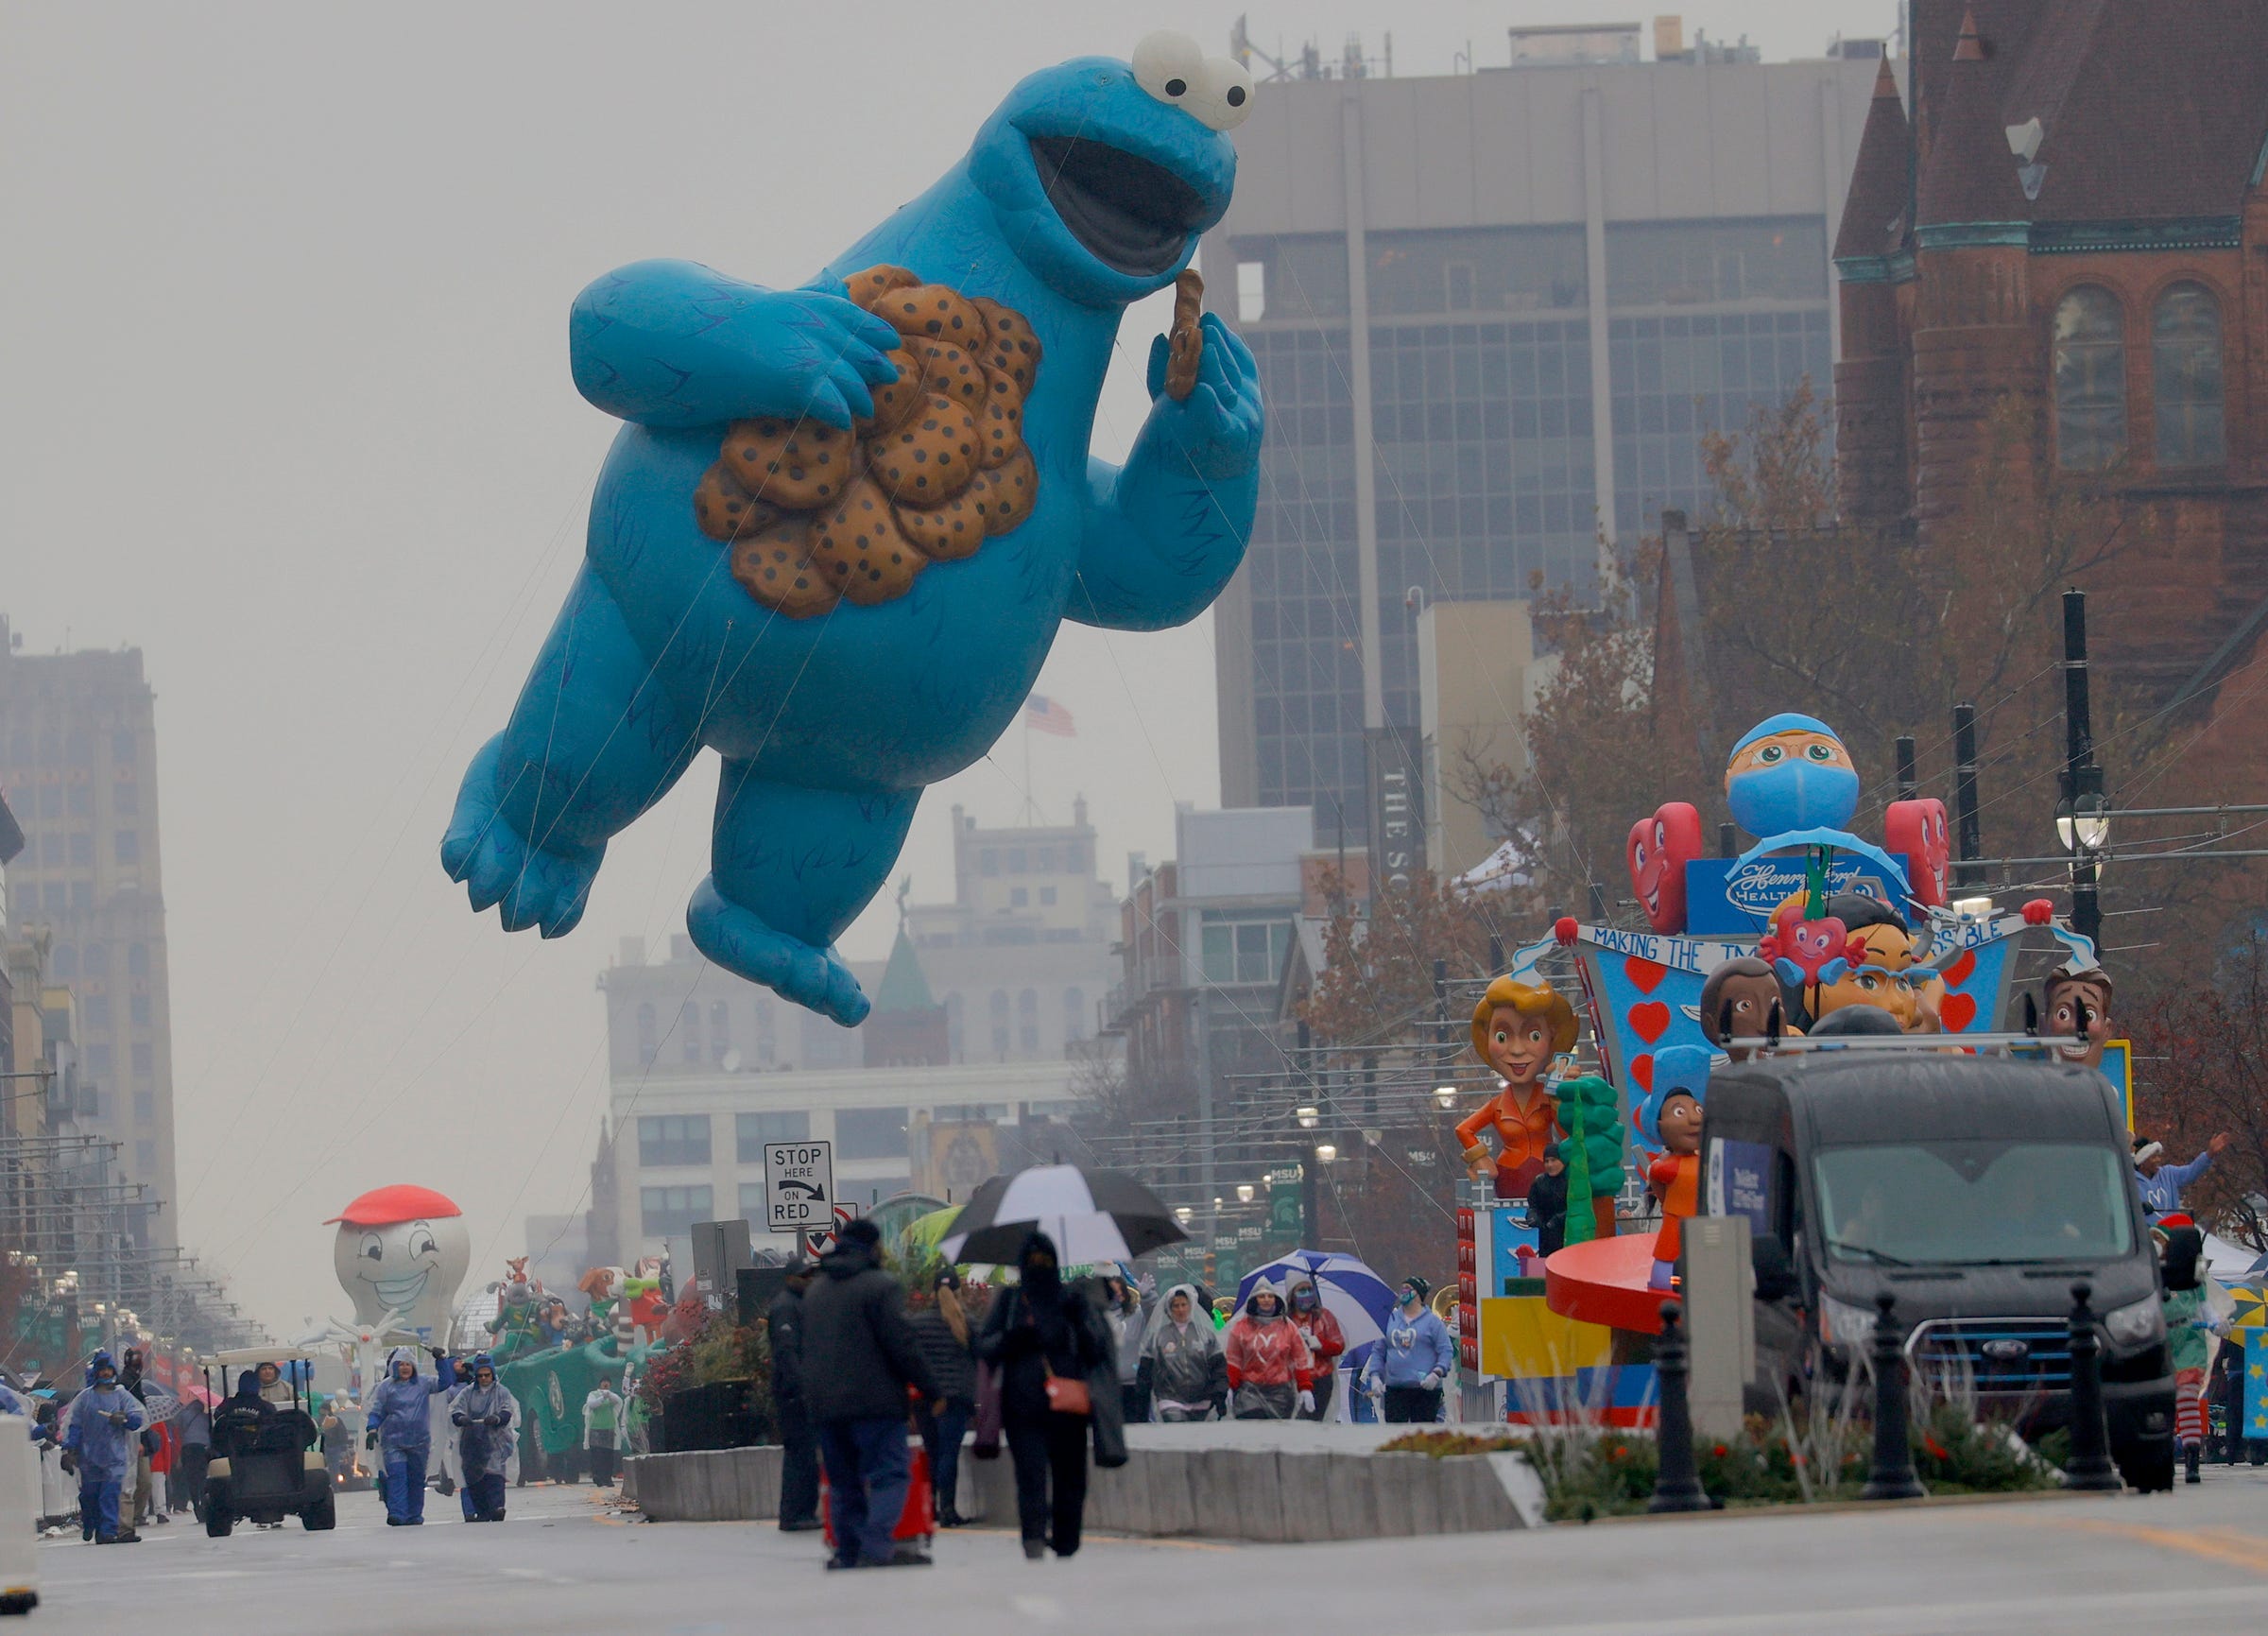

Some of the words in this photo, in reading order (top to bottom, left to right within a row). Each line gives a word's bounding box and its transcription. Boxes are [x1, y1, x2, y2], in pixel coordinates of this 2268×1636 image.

[1383, 766, 1407, 839] THE
[1741, 864, 1810, 892] Henry
[1593, 927, 1659, 960] MAKING
[1667, 939, 1705, 973] THE
[775, 1148, 821, 1165] STOP
[784, 1167, 814, 1178] HERE
[1271, 1169, 1297, 1180] MSU
[784, 1191, 799, 1200] ON
[775, 1203, 810, 1220] RED
[1239, 1228, 1263, 1237] MSU
[1215, 1237, 1238, 1246] MSU
[1184, 1248, 1207, 1256] MSU
[1157, 1256, 1178, 1265] MSU
